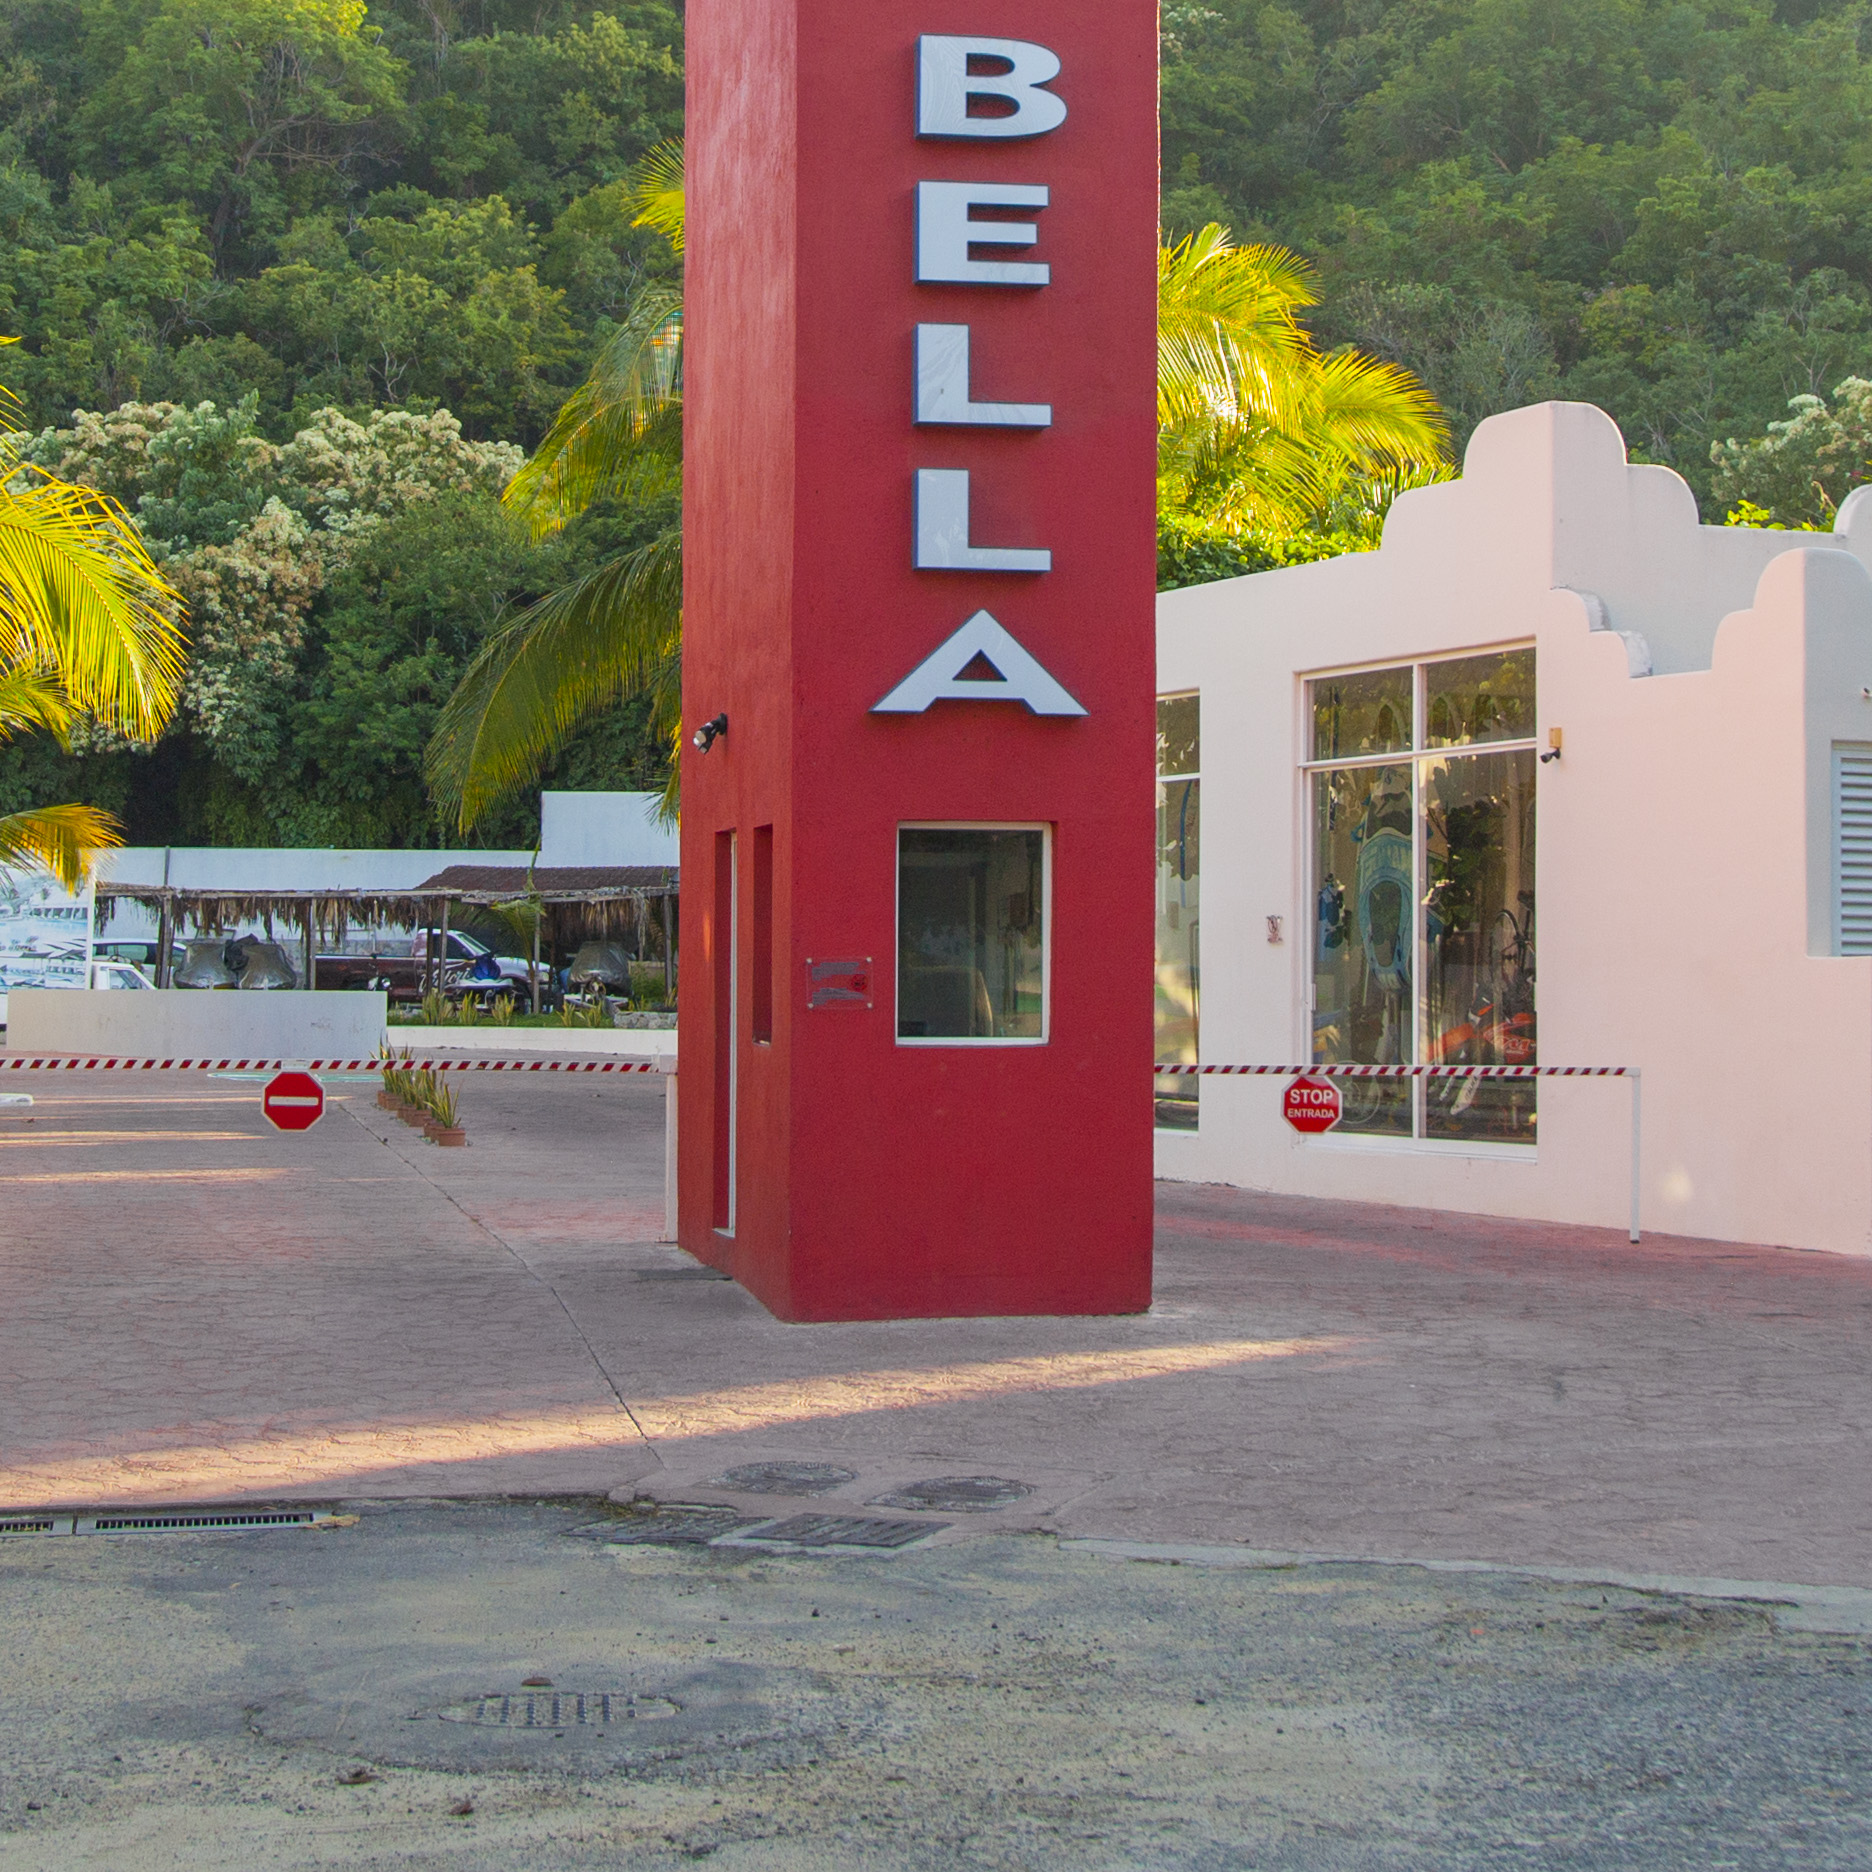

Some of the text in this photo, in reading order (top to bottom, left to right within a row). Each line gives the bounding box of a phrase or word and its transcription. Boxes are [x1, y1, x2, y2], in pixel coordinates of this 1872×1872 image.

[868, 32, 1090, 718] BELLA
[1287, 1088, 1336, 1119] STOP ENTRADA
